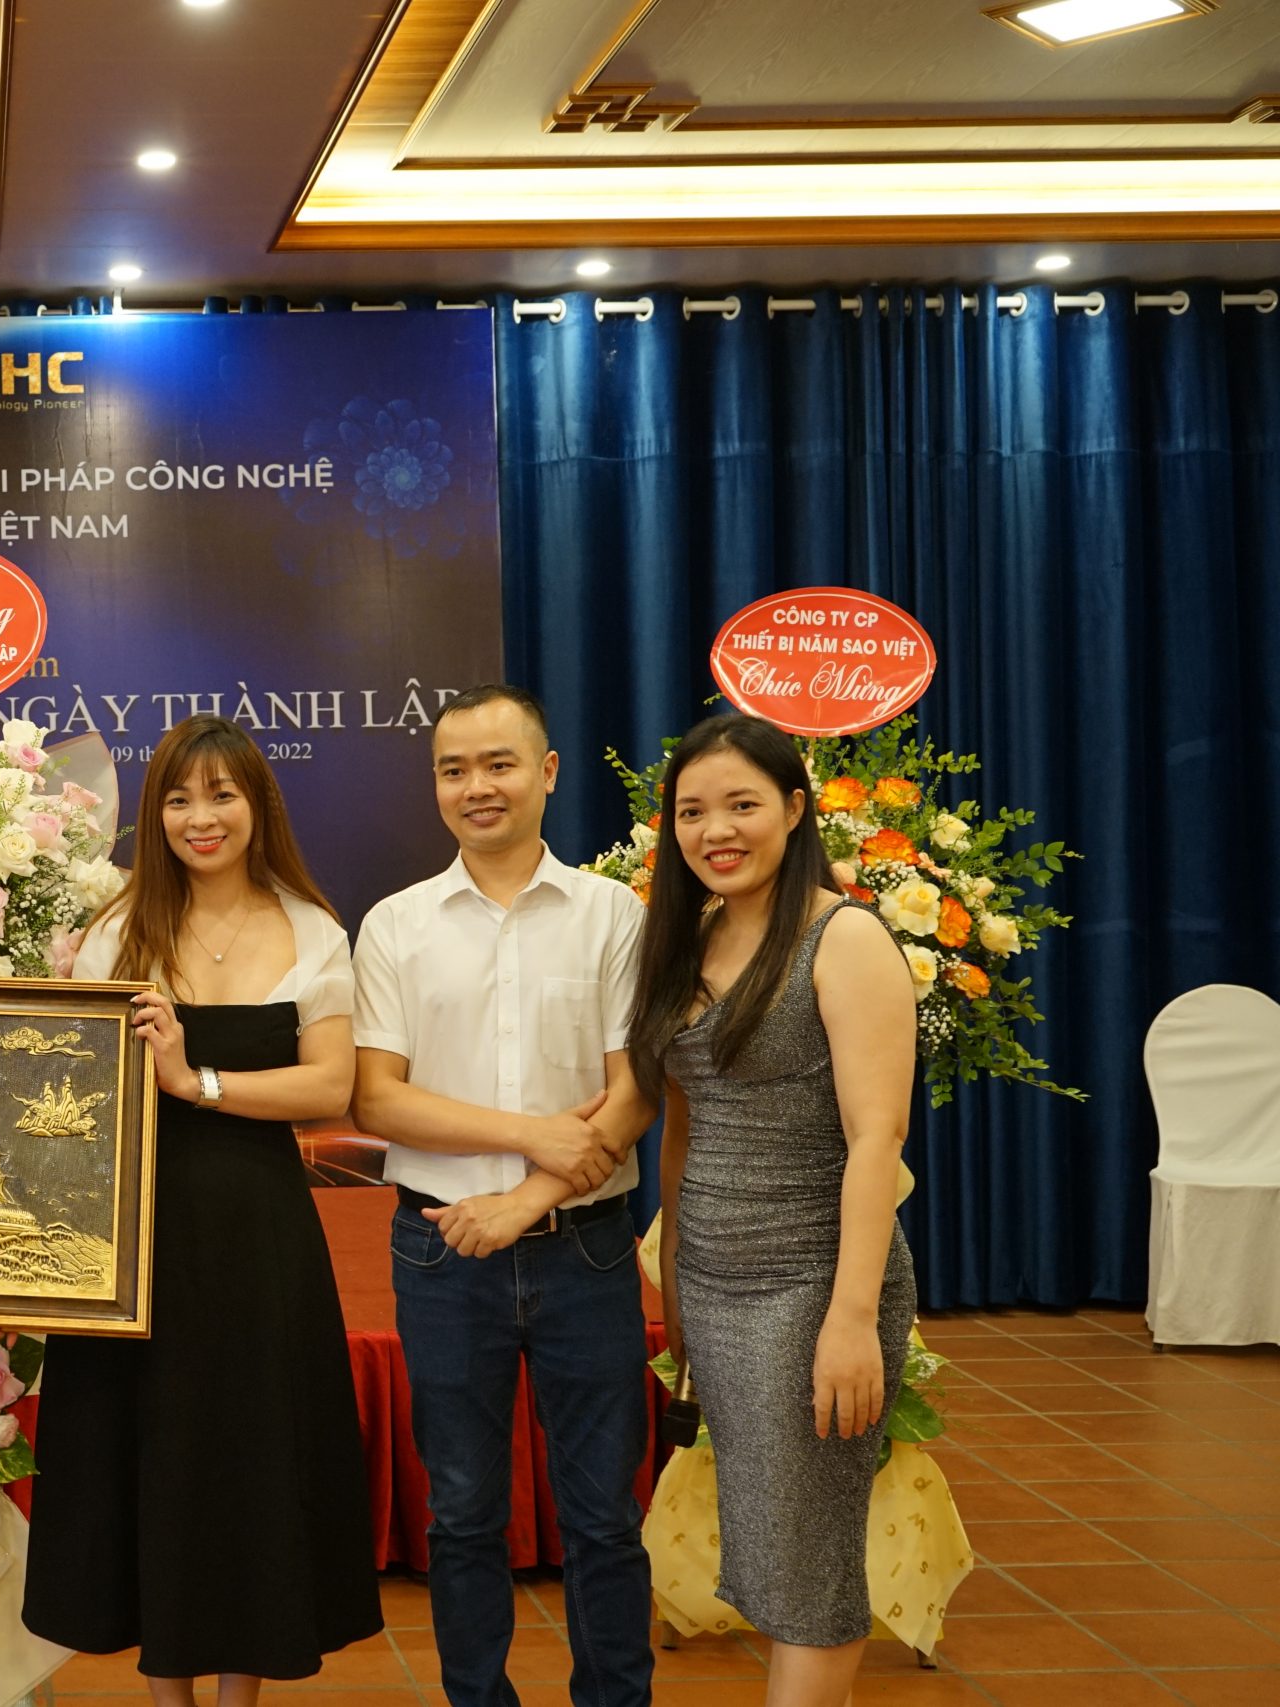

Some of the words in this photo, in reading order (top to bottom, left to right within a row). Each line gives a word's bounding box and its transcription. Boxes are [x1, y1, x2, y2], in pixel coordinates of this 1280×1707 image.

[34, 399, 84, 409] Pioneer
[21, 461, 115, 492] PHÁP
[125, 460, 225, 490] CÔNG
[237, 457, 334, 494] NGHỆ
[51, 514, 129, 539] NAM
[773, 605, 825, 626] CÔNG
[830, 611, 849, 627] TY
[854, 611, 879, 628] CP
[732, 628, 774, 650] THIẾT
[778, 636, 794, 656] BỊ
[798, 634, 837, 654] NĂM
[842, 638, 878, 656] SAO
[883, 636, 917, 660] VIỆT
[738, 657, 802, 697] Chúc
[809, 660, 903, 718] Mừng
[152, 681, 345, 731] THÀNH
[268, 743, 312, 760] 2022
